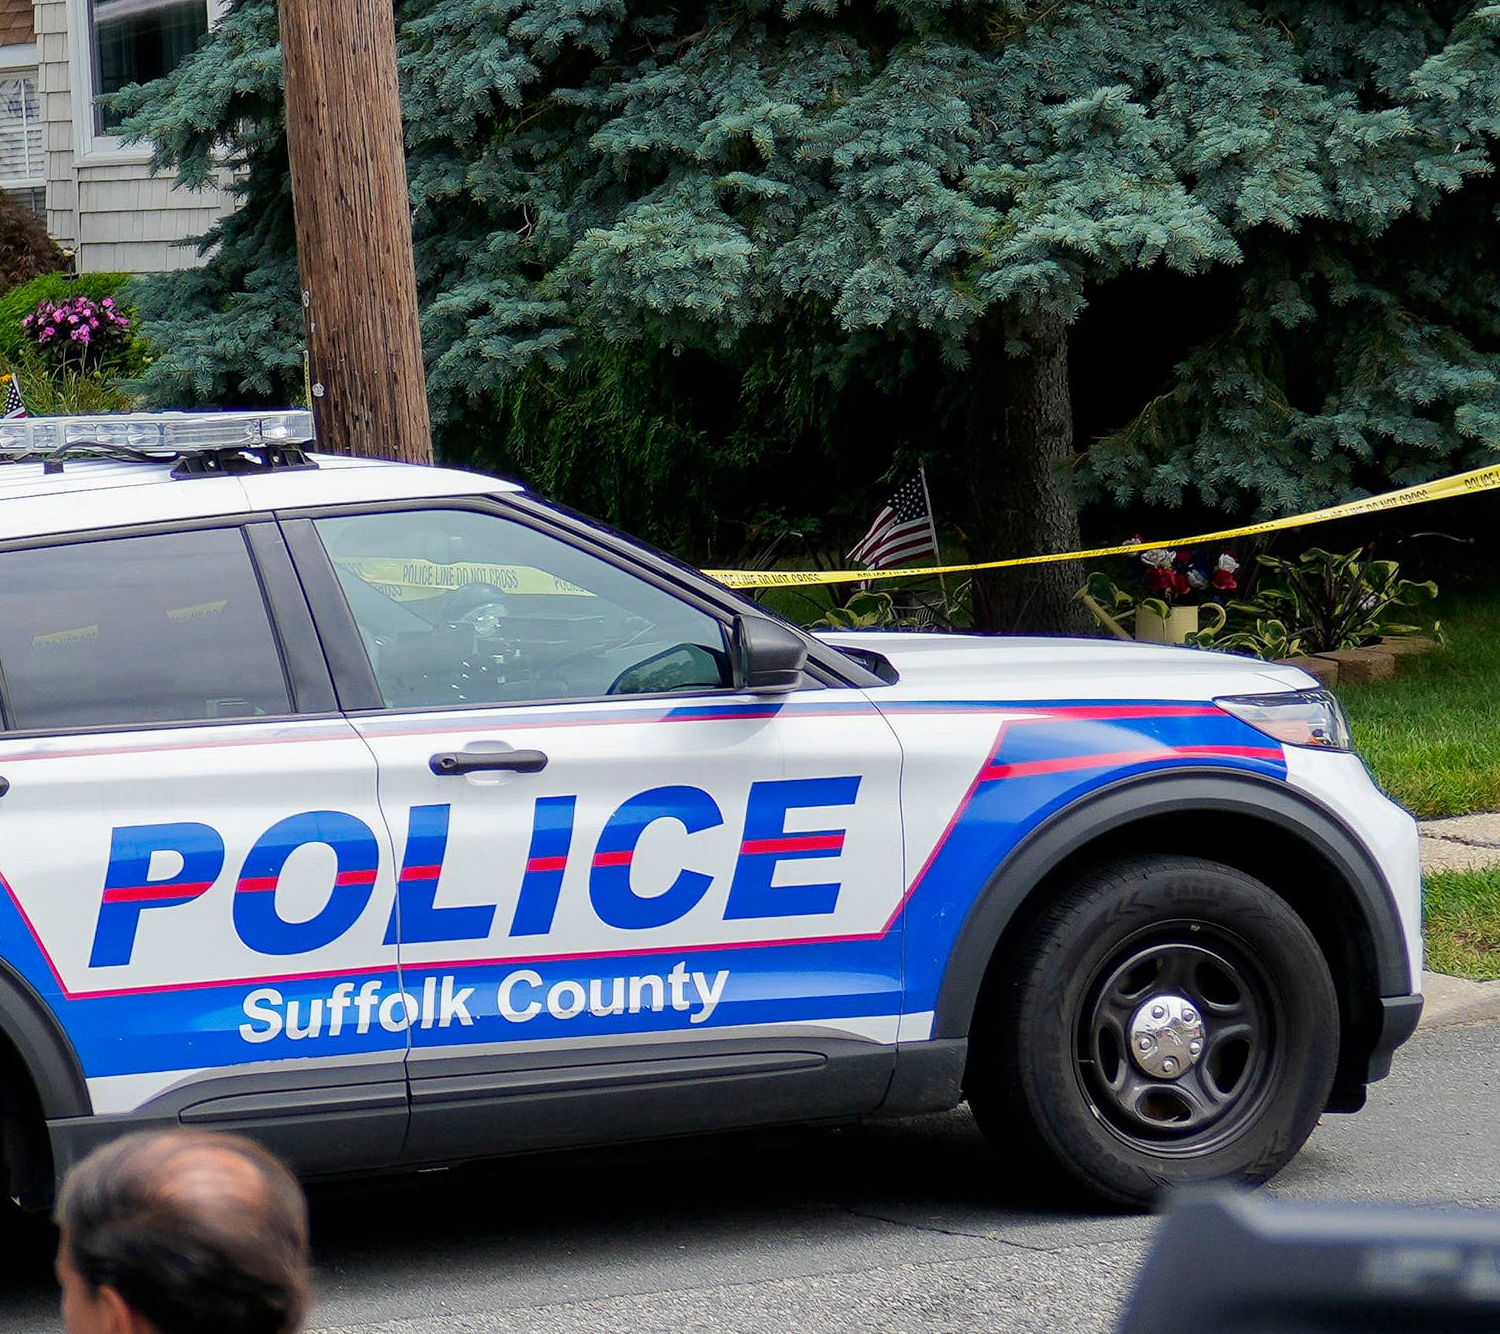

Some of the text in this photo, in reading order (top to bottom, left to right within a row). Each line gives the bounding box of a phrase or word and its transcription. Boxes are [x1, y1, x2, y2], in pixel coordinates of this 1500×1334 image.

[403, 564, 519, 589] POLICE LINE DO NOT CROSS
[88, 774, 863, 969] POLICE
[239, 960, 731, 1045] Suffolk County
